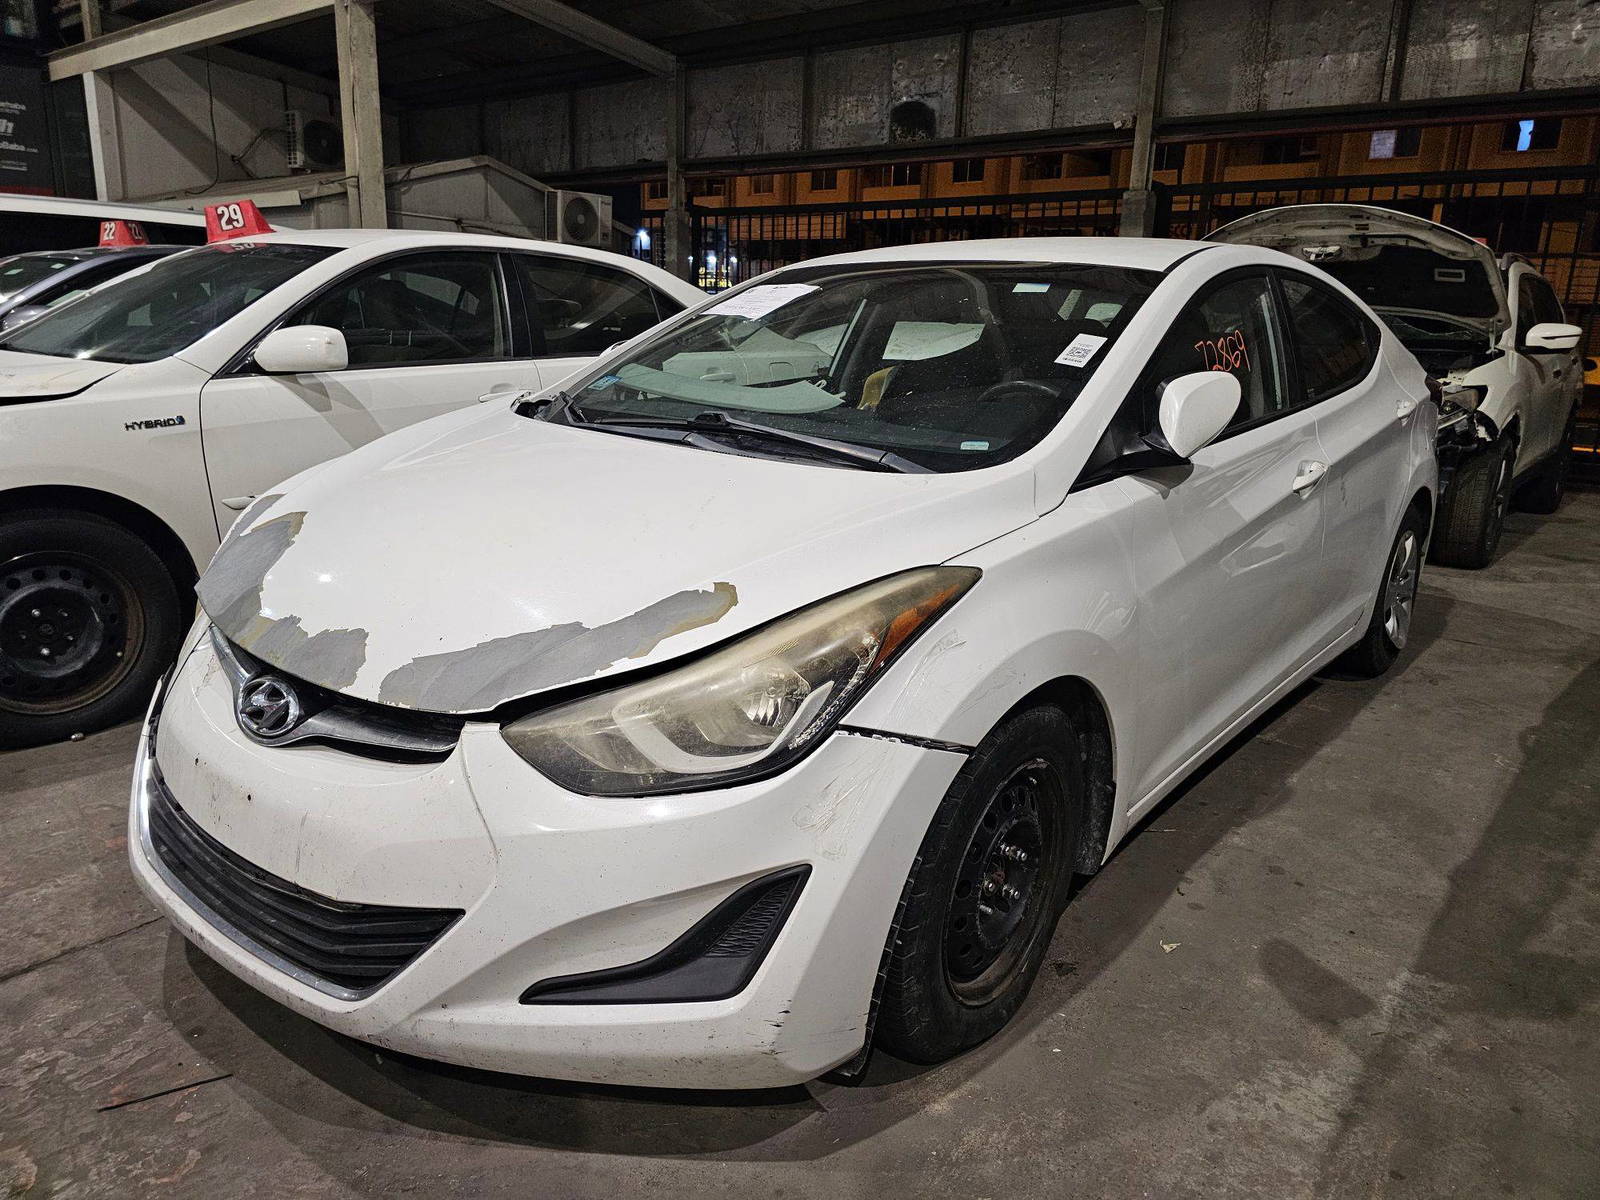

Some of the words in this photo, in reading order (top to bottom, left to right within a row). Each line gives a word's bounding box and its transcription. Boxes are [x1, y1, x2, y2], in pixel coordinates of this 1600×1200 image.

[217, 204, 243, 231] 29
[103, 222, 115, 241] 22
[1194, 329, 1251, 372] 72869
[125, 418, 176, 431] HYBRID
